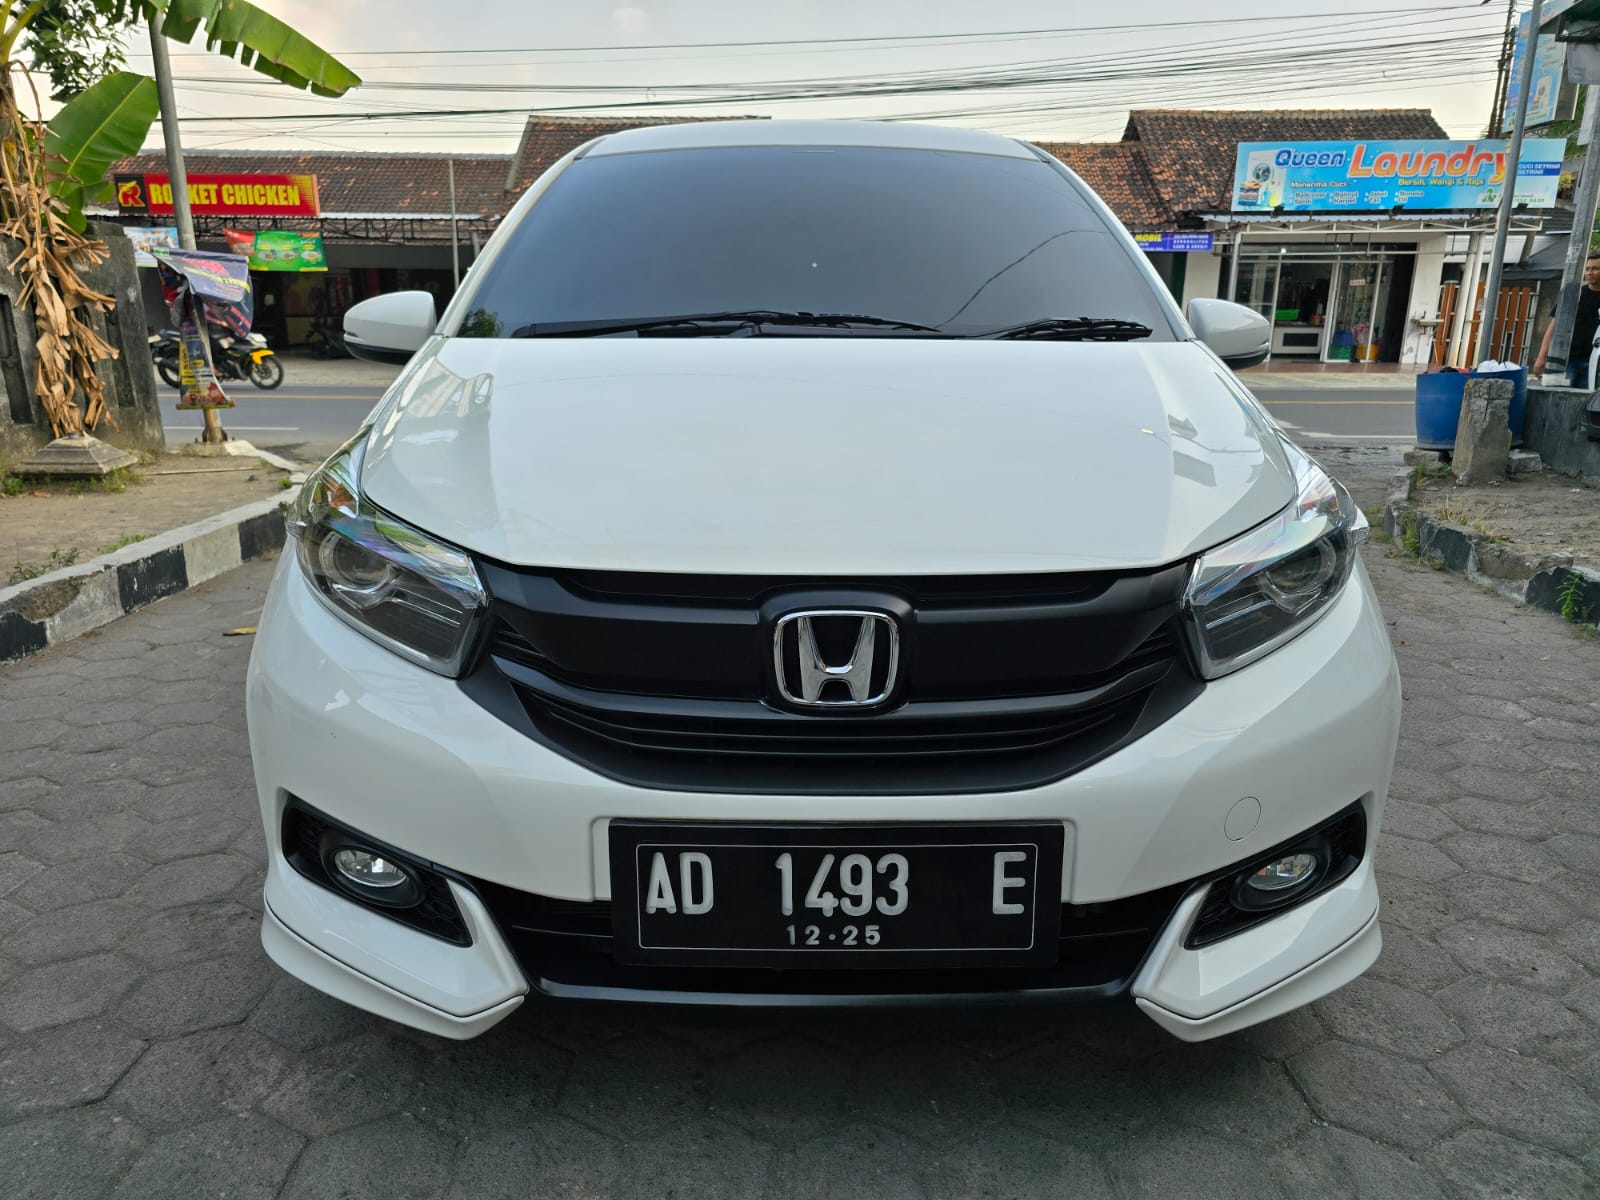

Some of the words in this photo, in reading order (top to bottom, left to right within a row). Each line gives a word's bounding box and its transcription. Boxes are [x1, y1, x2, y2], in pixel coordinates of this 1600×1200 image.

[1275, 148, 1346, 168] Queen
[1348, 144, 1507, 184] Laundry
[149, 183, 218, 205] ROKET
[221, 183, 301, 207] CHICKEN
[1430, 178, 1454, 186] Wangi
[1465, 178, 1485, 186] Rapi
[645, 851, 714, 914] AD
[775, 852, 909, 917] 1493
[992, 851, 1027, 915] E
